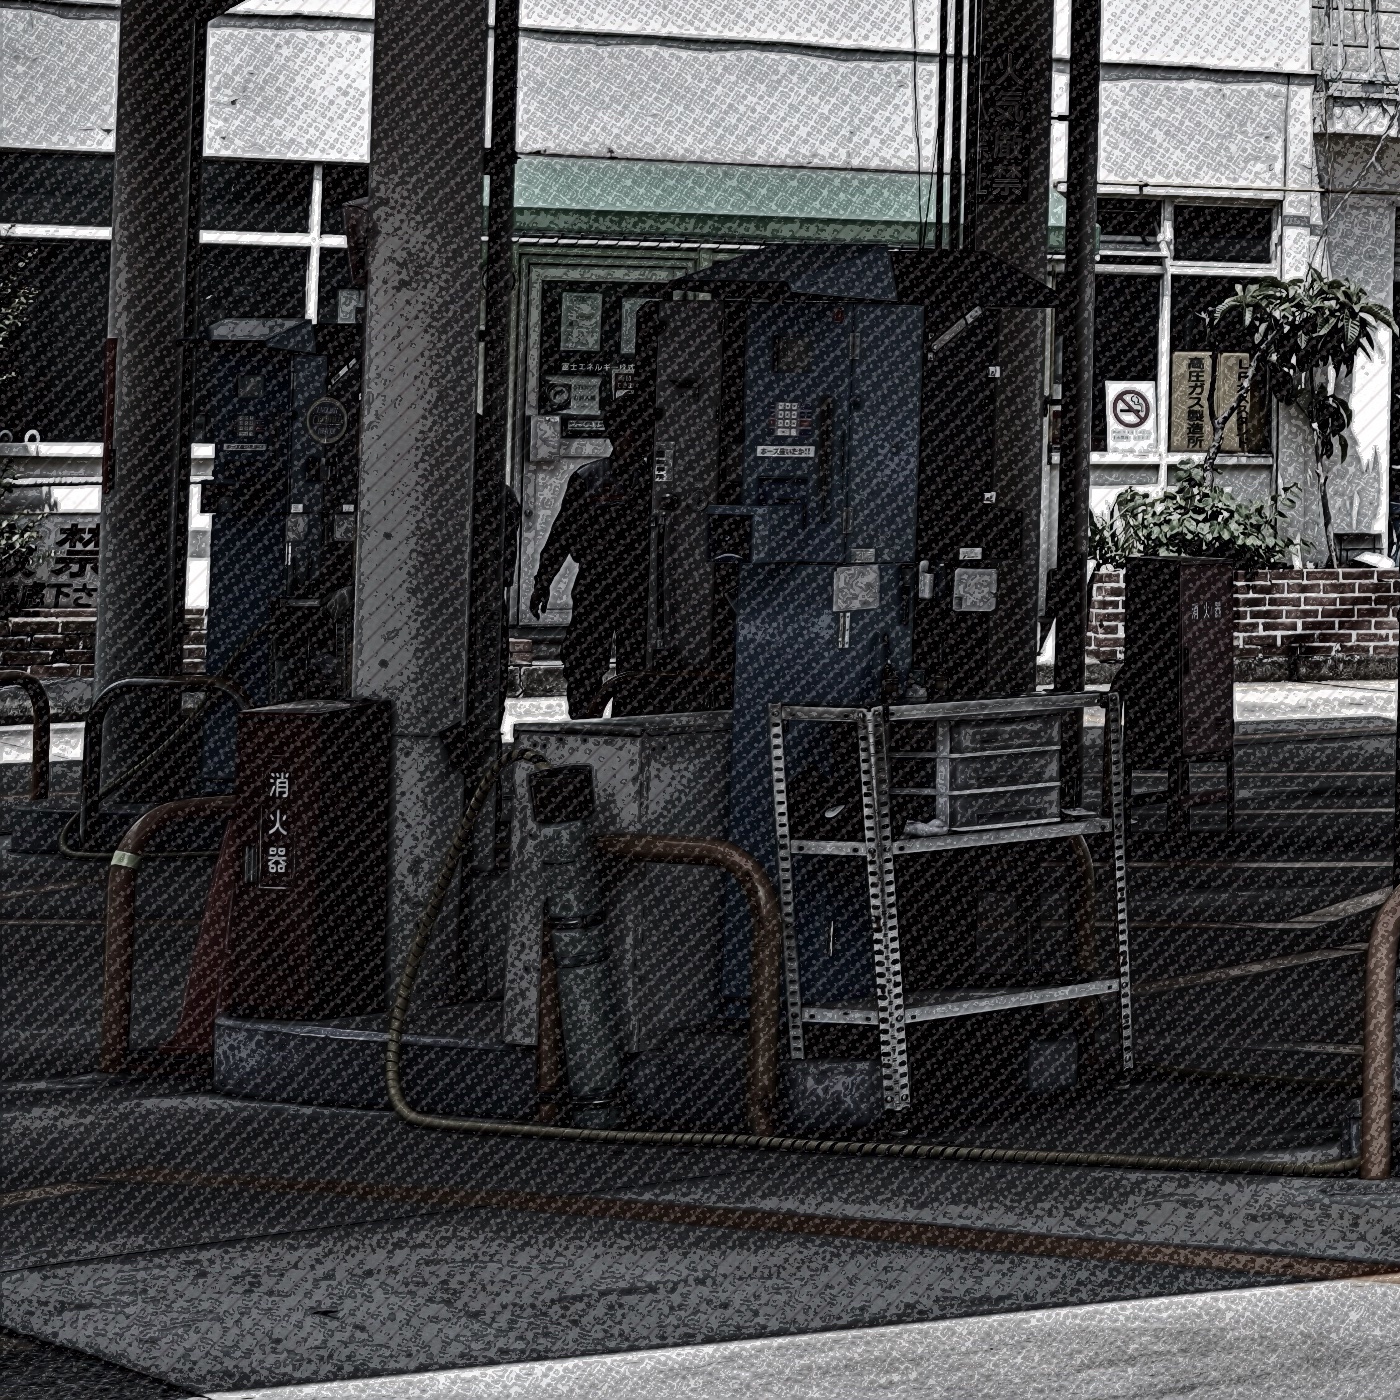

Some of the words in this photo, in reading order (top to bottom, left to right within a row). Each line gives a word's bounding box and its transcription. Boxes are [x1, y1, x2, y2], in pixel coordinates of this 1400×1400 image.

[1187, 357, 1205, 449] 高圧ガス製造所
[267, 772, 290, 873] 消火器
